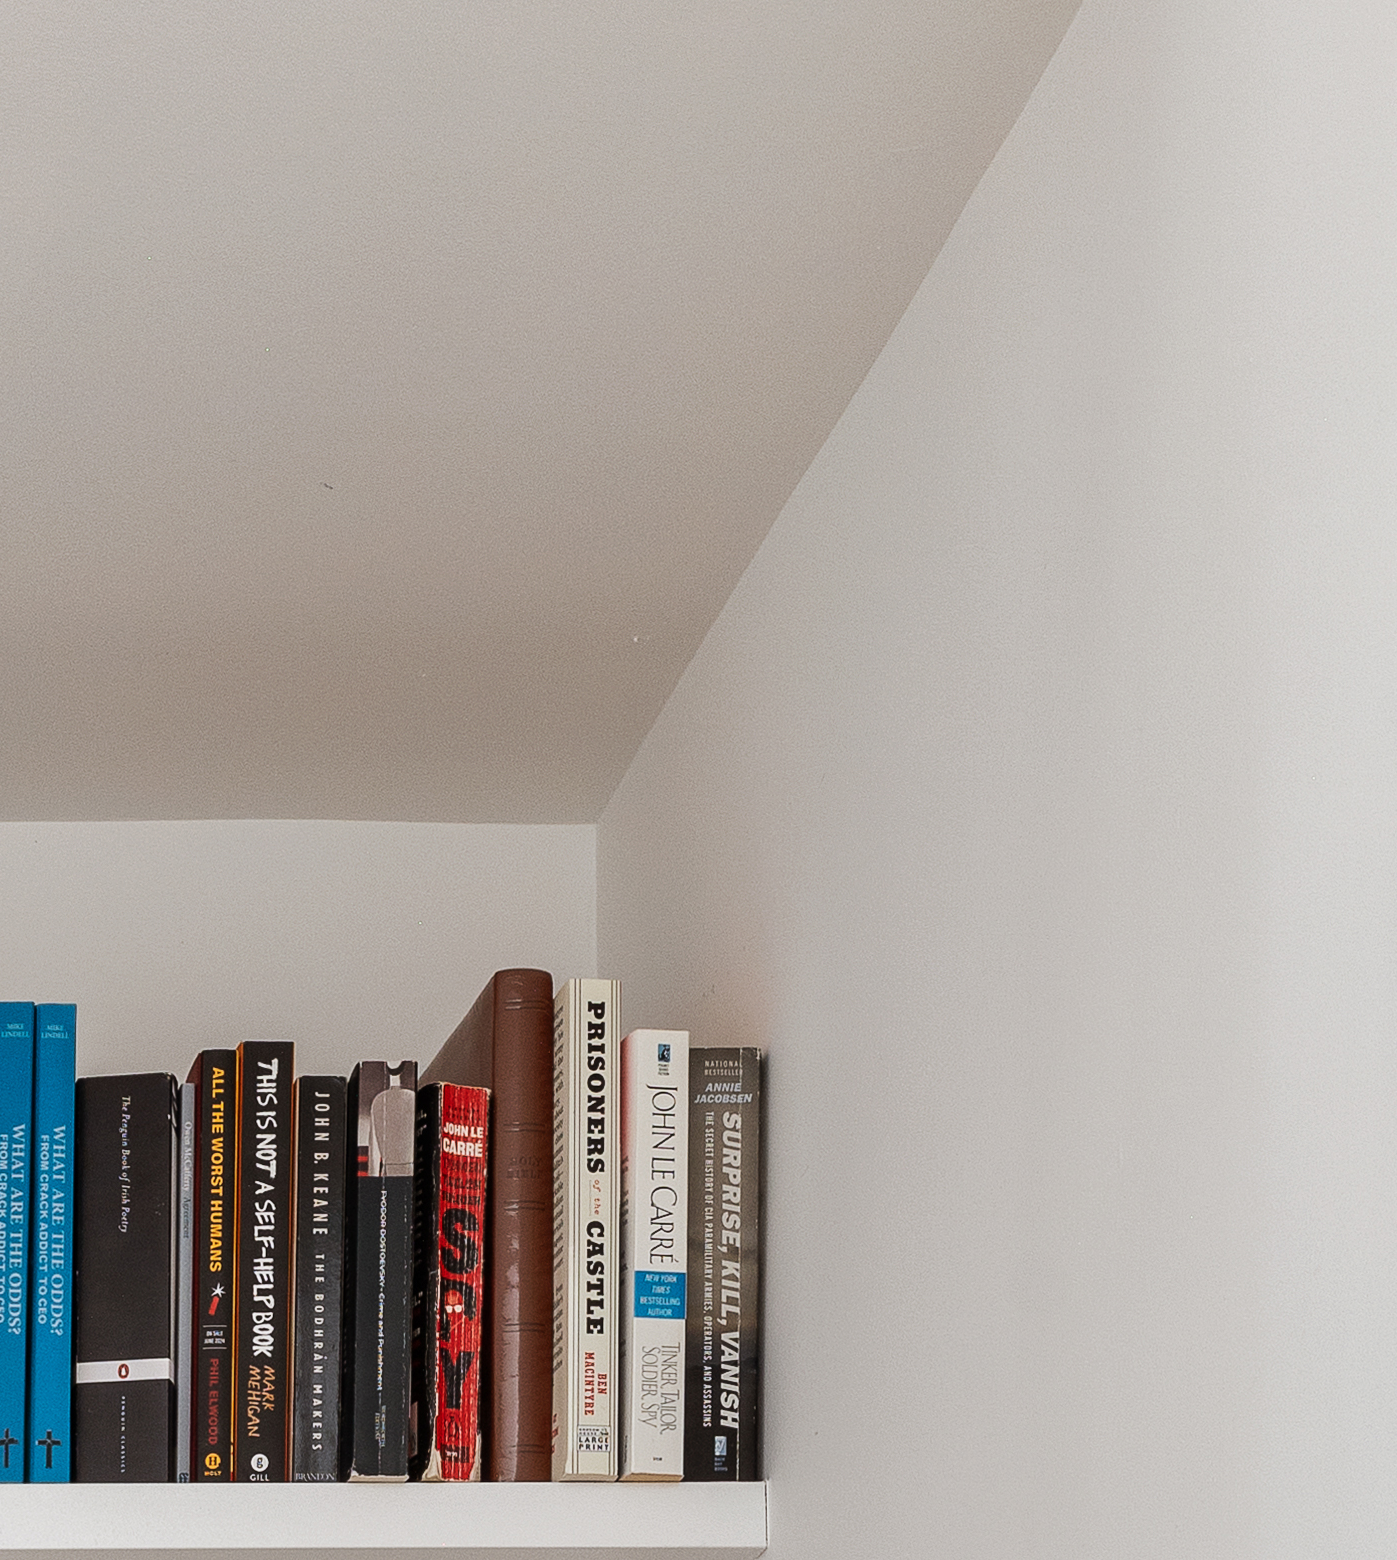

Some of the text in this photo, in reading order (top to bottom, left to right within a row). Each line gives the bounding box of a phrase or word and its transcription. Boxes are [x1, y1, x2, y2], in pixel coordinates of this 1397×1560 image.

[209, 1067, 224, 1272] ALL THE WORST HUMANS
[586, 1001, 606, 1173] PRISONERS
[585, 1221, 604, 1335] CASTLE
[719, 1111, 741, 1428] SURPRISE, KILL, VANISH
